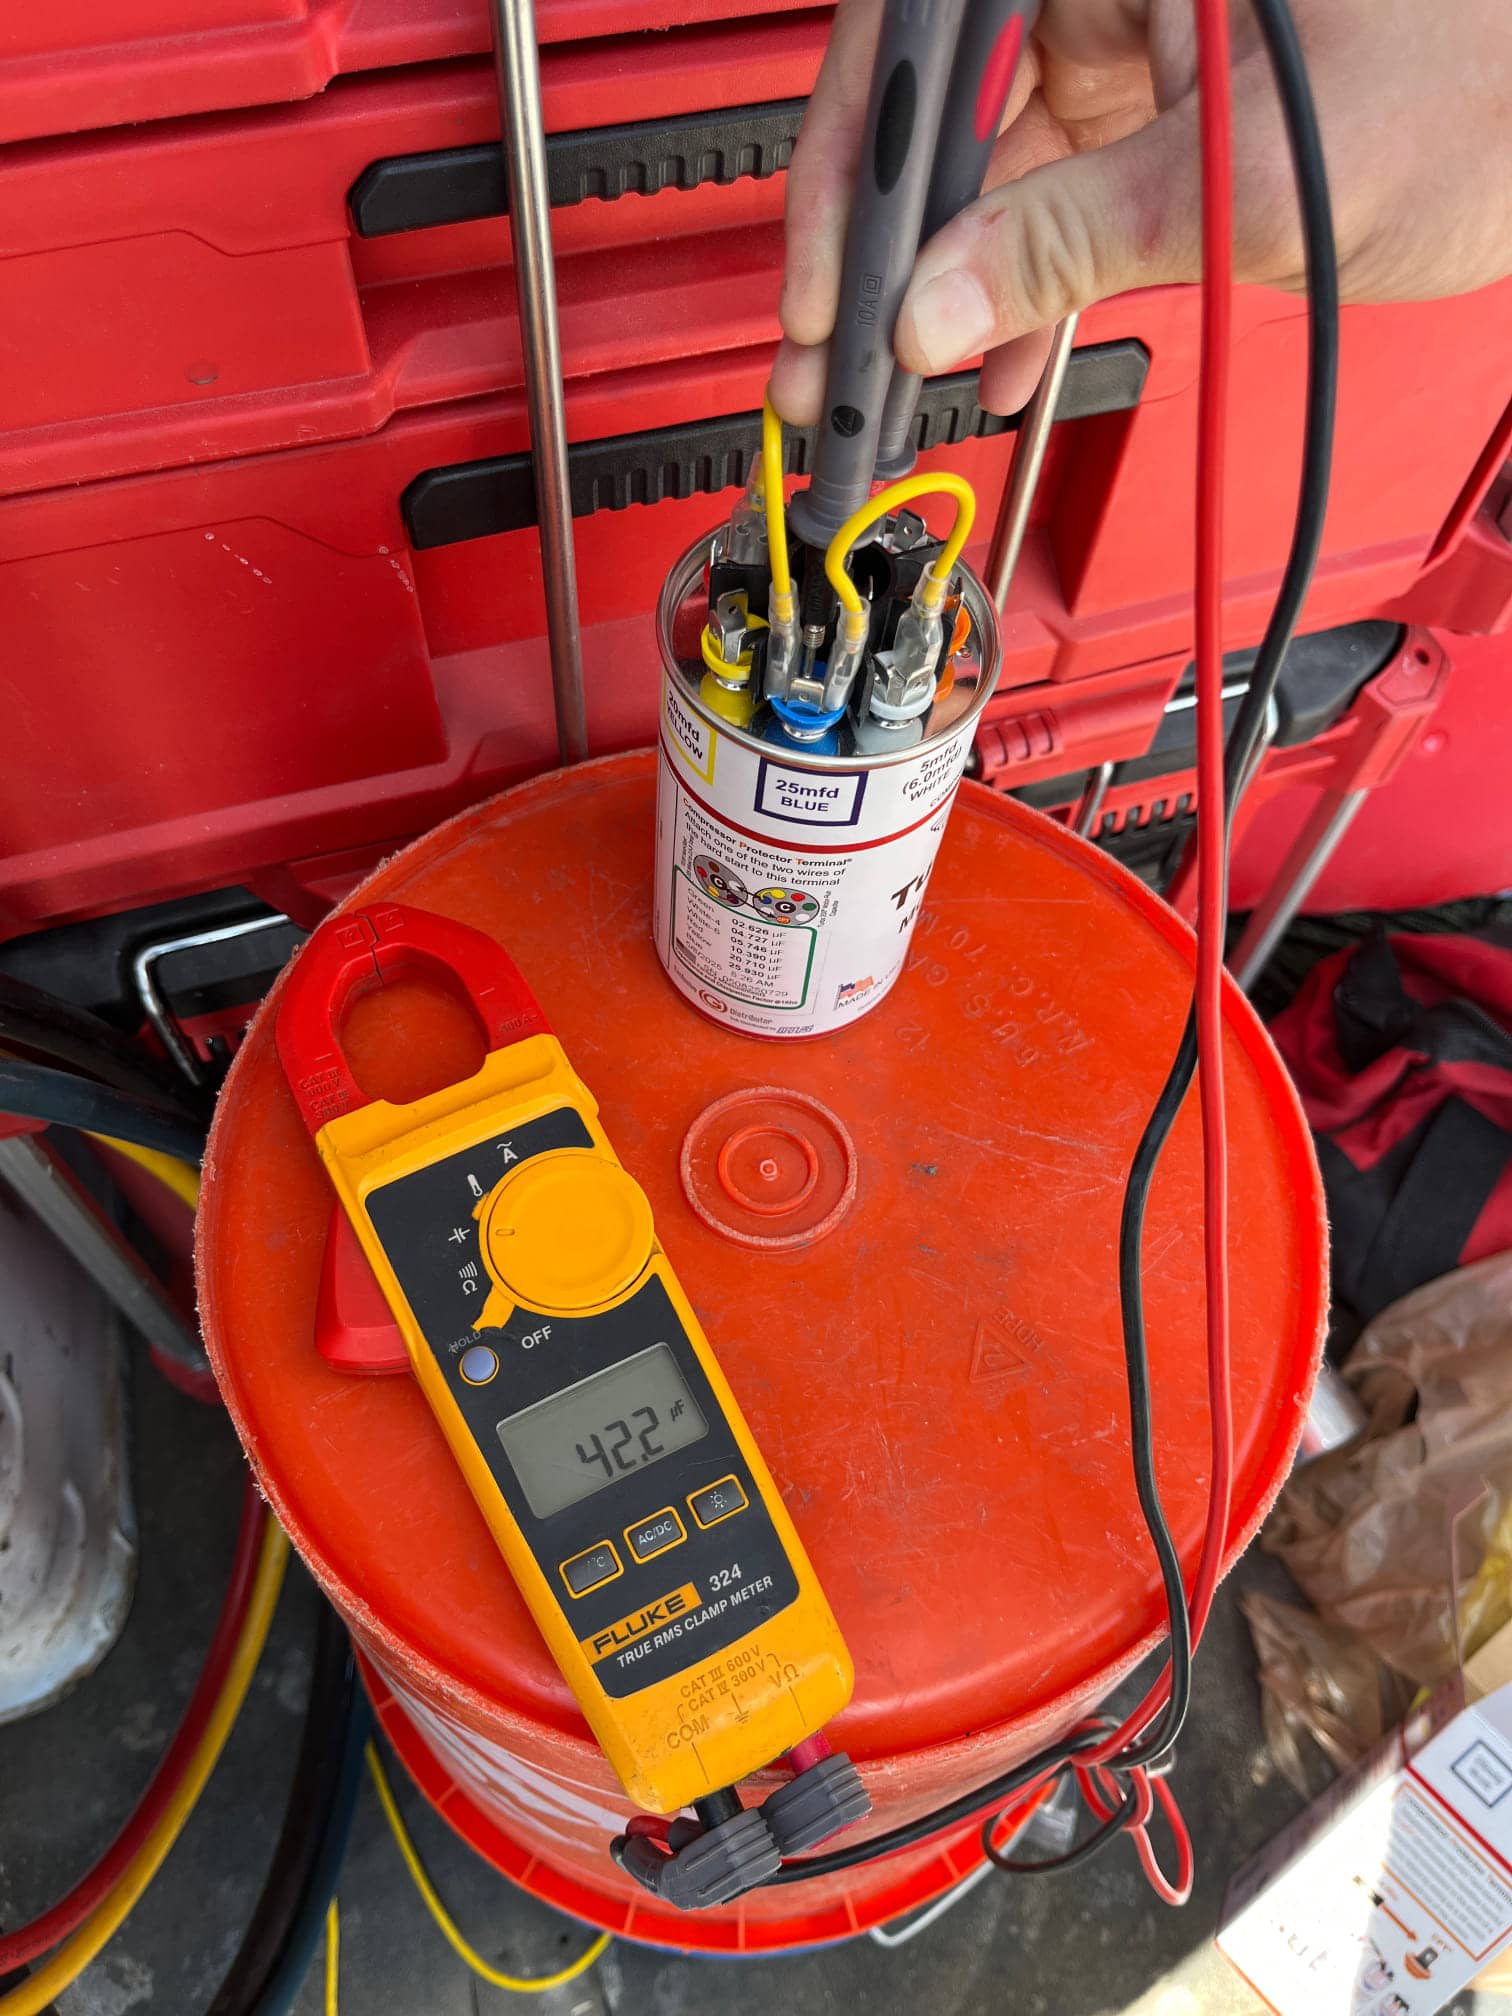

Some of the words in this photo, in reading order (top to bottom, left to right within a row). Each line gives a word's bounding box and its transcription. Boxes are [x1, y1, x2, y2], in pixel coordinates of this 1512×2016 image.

[856, 299, 879, 328] 10A
[667, 699, 703, 759] YELLOW
[668, 689, 700, 742] 20mfd
[902, 746, 962, 795] (6.0mfd)
[920, 739, 959, 773] 5mfd
[775, 779, 840, 799] 25mfd
[780, 796, 830, 812] BLUE
[683, 798, 737, 844] Compressor
[739, 841, 793, 864] Protector
[684, 811, 712, 840] Attach
[714, 838, 734, 854] one
[736, 851, 748, 861] of
[750, 856, 769, 869] the
[772, 863, 794, 875] two
[797, 868, 830, 877] wires
[833, 868, 847, 877] of
[700, 836, 722, 857] hard
[725, 855, 750, 872] start
[752, 867, 763, 877] to
[766, 871, 788, 883] this
[791, 877, 841, 887] terminal
[450, 1330, 481, 1352] HOLD
[521, 1325, 552, 1350] OFF
[575, 1406, 665, 1478] 42.2
[638, 1520, 673, 1545] AC/DC
[709, 1563, 743, 1592] 324
[592, 1594, 687, 1656] FLUKE
[616, 1641, 653, 1668] TRUE
[653, 1624, 684, 1649] RMS
[684, 1600, 728, 1631] CLAMP
[730, 1575, 774, 1607] METER
[680, 1675, 707, 1698] CAT
[708, 1665, 725, 1683] III
[726, 1651, 752, 1672] 600
[751, 1644, 761, 1657] V
[688, 1688, 715, 1712] CAT
[731, 1666, 757, 1687] 300
[755, 1659, 765, 1672] V
[769, 1670, 782, 1689] V
[667, 1714, 710, 1749] COM
